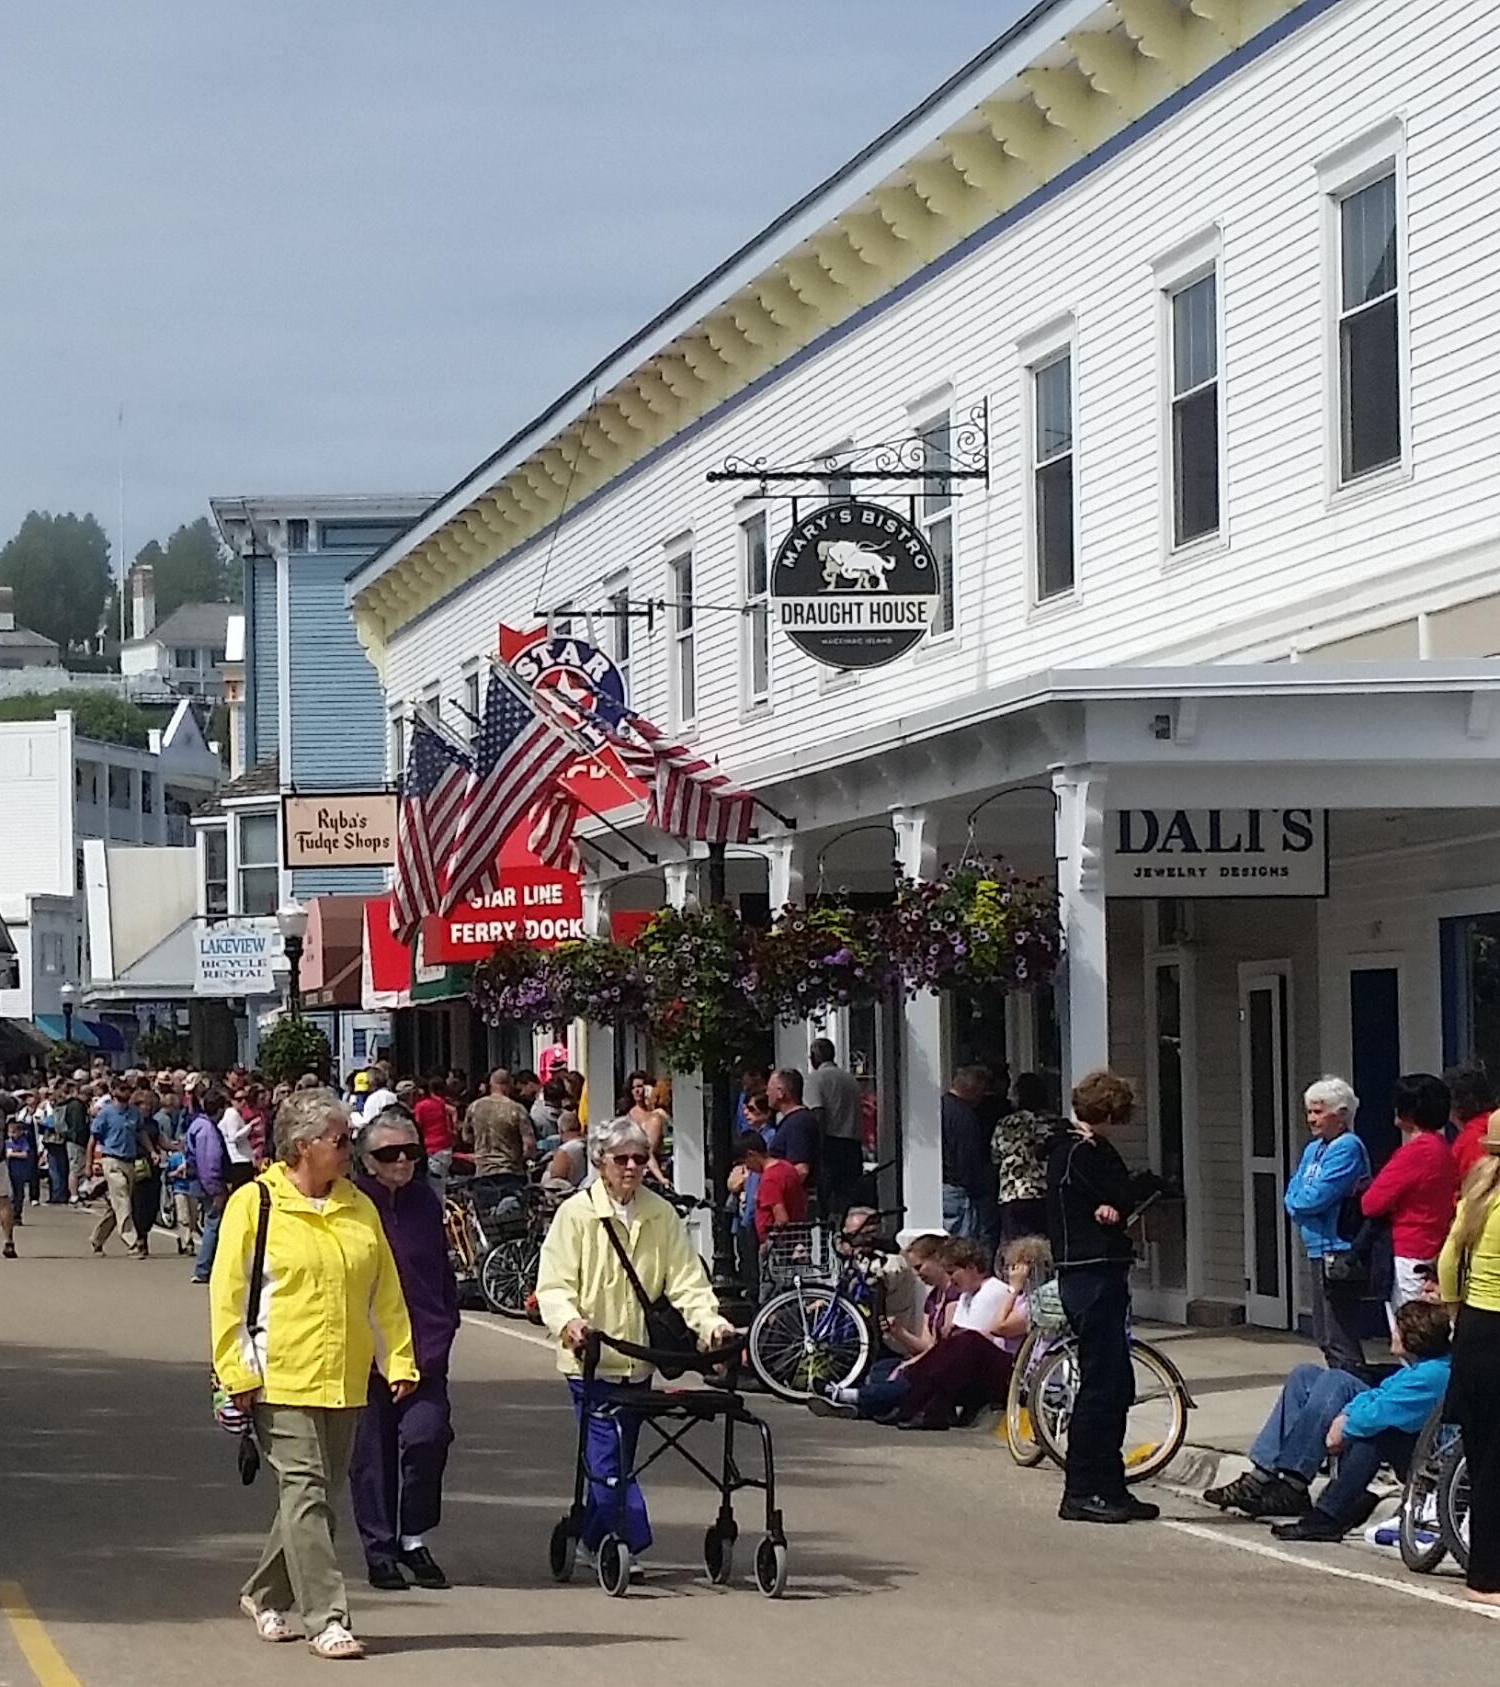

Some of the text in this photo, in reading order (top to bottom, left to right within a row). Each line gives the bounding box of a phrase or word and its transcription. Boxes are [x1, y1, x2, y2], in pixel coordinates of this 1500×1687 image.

[782, 510, 928, 569] MARY'S BISTRO
[781, 601, 928, 625] DRAUGHT HOUSE
[515, 641, 610, 683] STAR
[317, 808, 368, 834] Ryba's
[1115, 809, 1314, 853] DALIS
[294, 831, 390, 854] Fudge Shops
[1133, 866, 1290, 878] JEWELRY DESIGNS
[523, 884, 563, 906] LINE
[450, 917, 586, 944] FERRY DOCK
[201, 937, 266, 954] LAKEVIEW
[201, 959, 267, 968] BICYCLE
[203, 969, 265, 979] RENTAL
